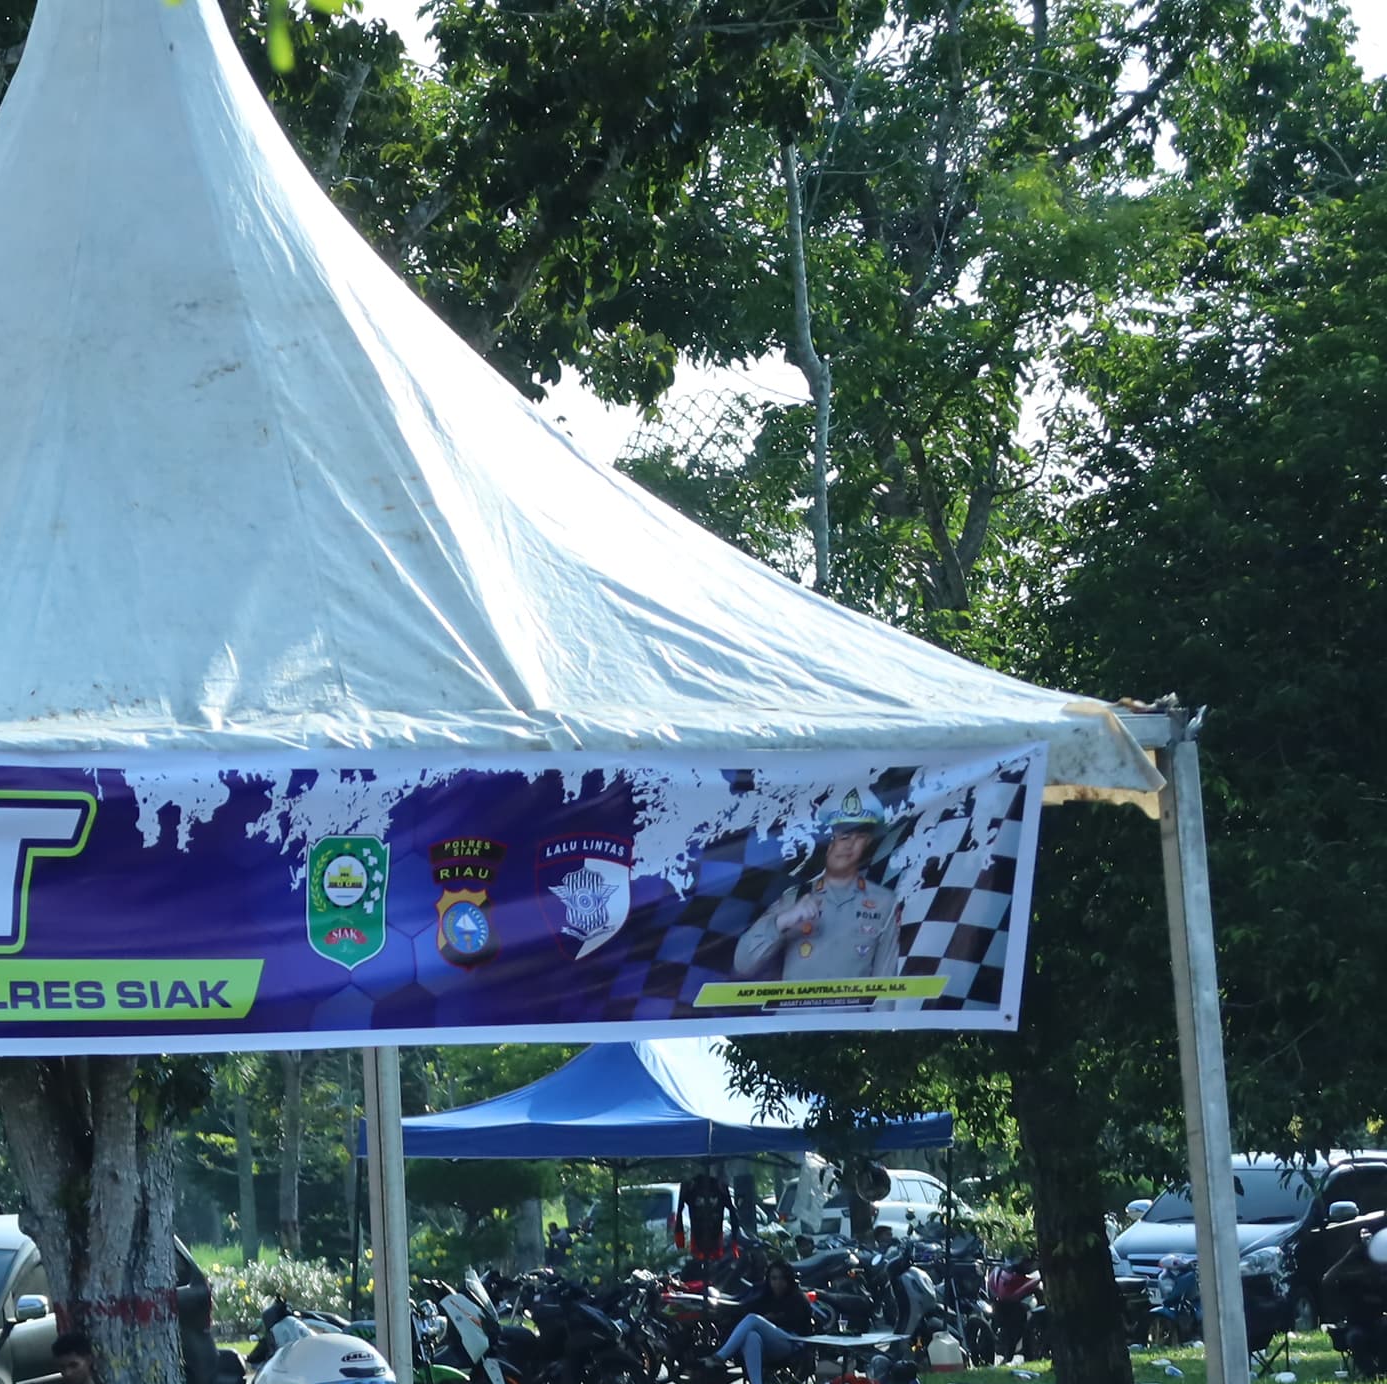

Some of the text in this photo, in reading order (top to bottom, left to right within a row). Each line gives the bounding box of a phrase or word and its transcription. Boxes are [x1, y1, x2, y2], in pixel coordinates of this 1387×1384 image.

[444, 839, 491, 851] POLRES
[546, 839, 625, 857] LALU LINTAS
[453, 847, 480, 857] SIAK
[439, 867, 491, 880] RIAU
[330, 928, 359, 941] SIAK
[116, 980, 233, 1009] SIAK
